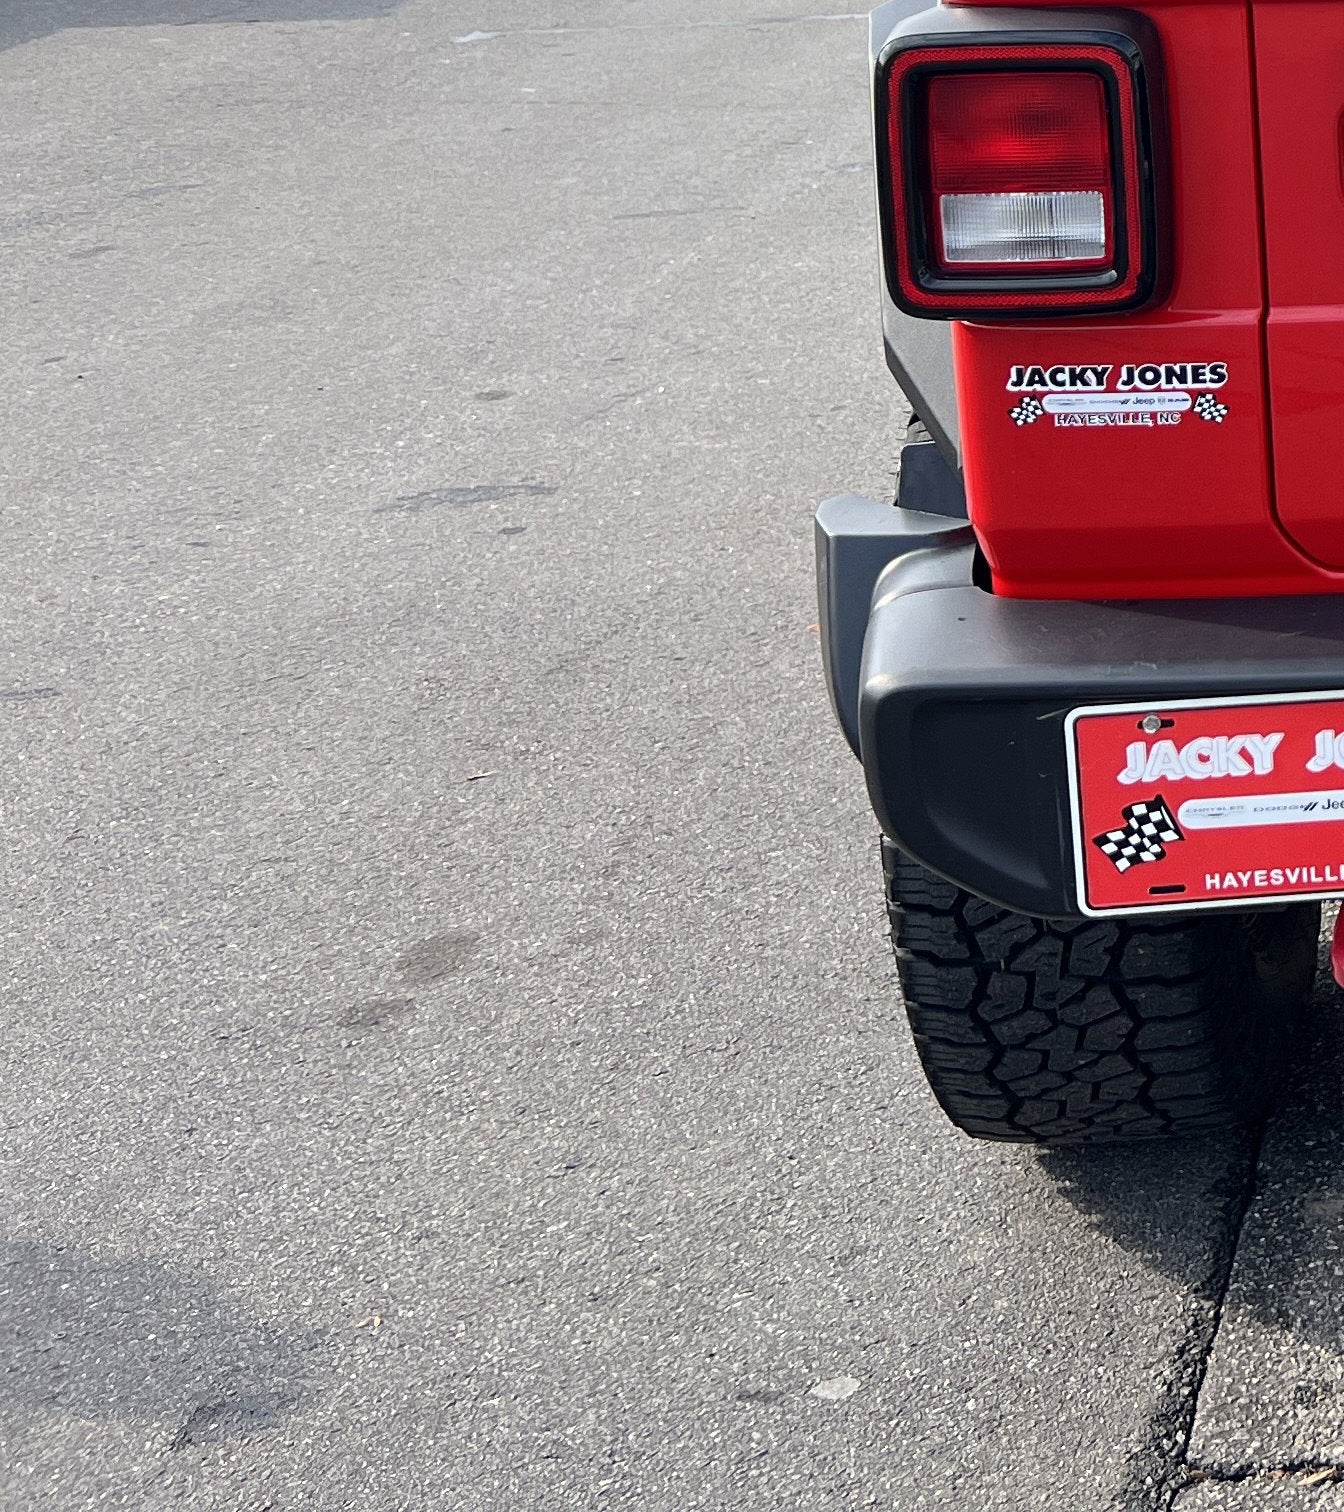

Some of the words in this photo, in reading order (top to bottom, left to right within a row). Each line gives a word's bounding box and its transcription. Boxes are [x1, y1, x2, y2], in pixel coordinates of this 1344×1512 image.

[1007, 364, 1113, 391] JACKY
[1117, 362, 1228, 391] JONES
[1132, 396, 1156, 406] Jeep
[1055, 412, 1154, 427] HAYESVILLE,
[1157, 411, 1182, 425] NC
[1117, 731, 1285, 785] JACKY
